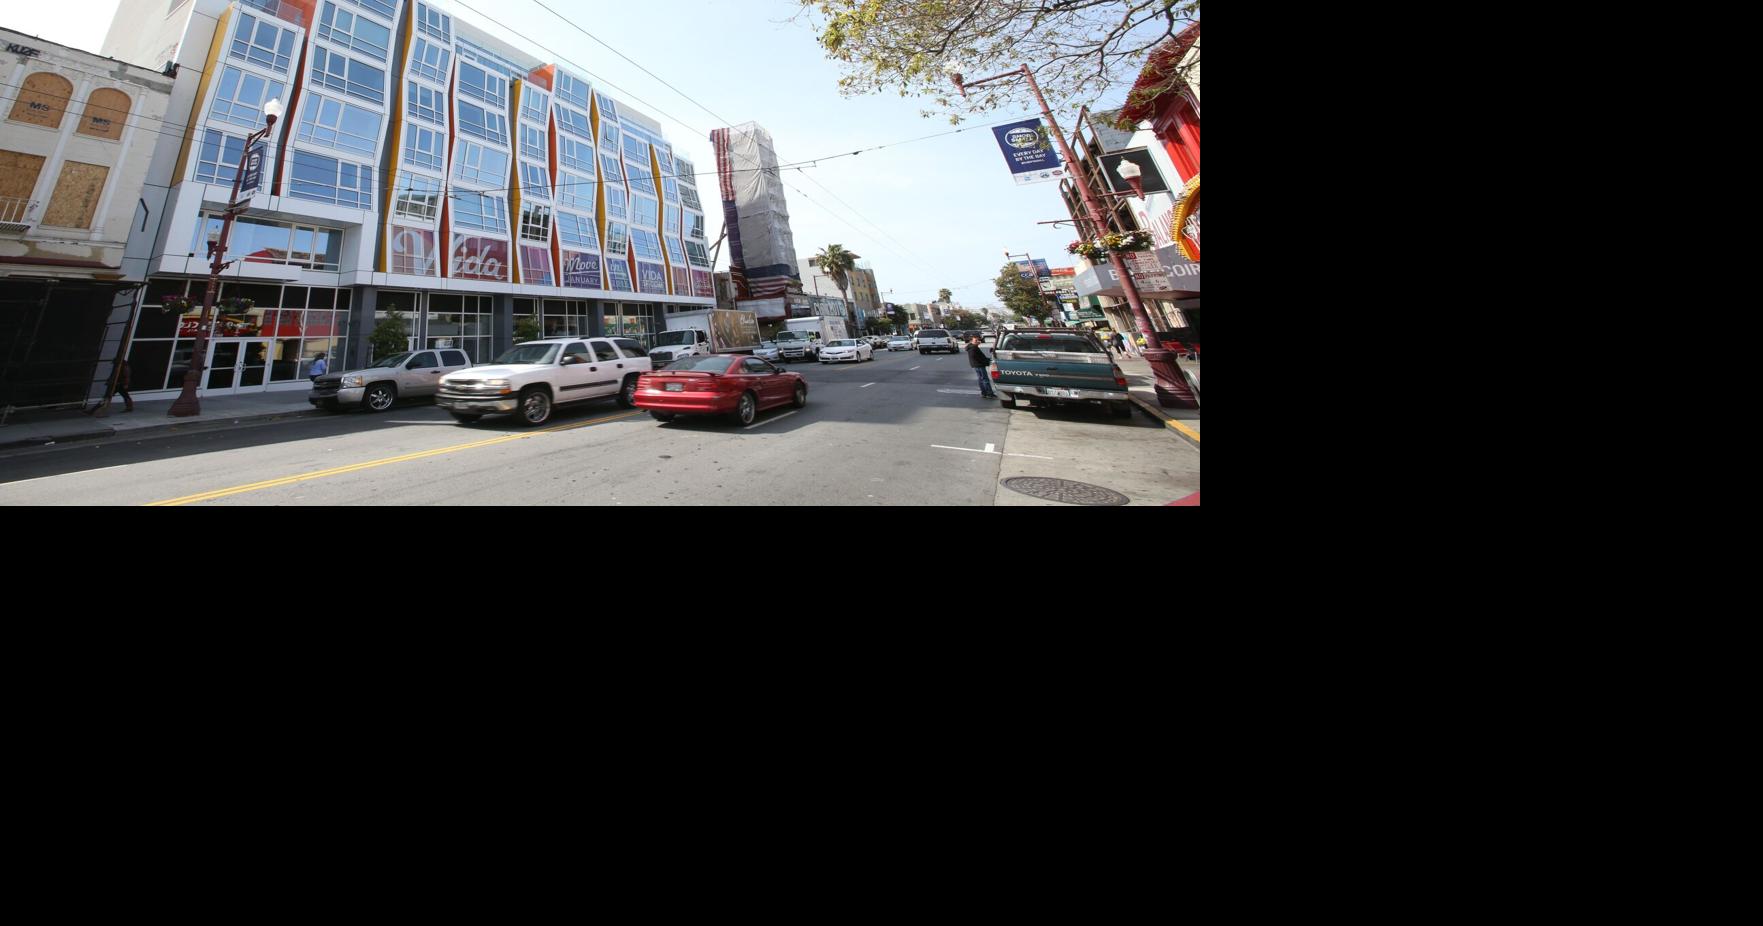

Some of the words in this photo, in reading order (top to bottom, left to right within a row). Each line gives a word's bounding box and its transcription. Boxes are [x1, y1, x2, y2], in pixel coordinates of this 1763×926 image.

[393, 231, 504, 280] Vida
[565, 255, 598, 272] Move
[564, 276, 598, 284] JANUARY
[641, 269, 663, 281] VIDA
[1000, 369, 1033, 377] TOYOTA
